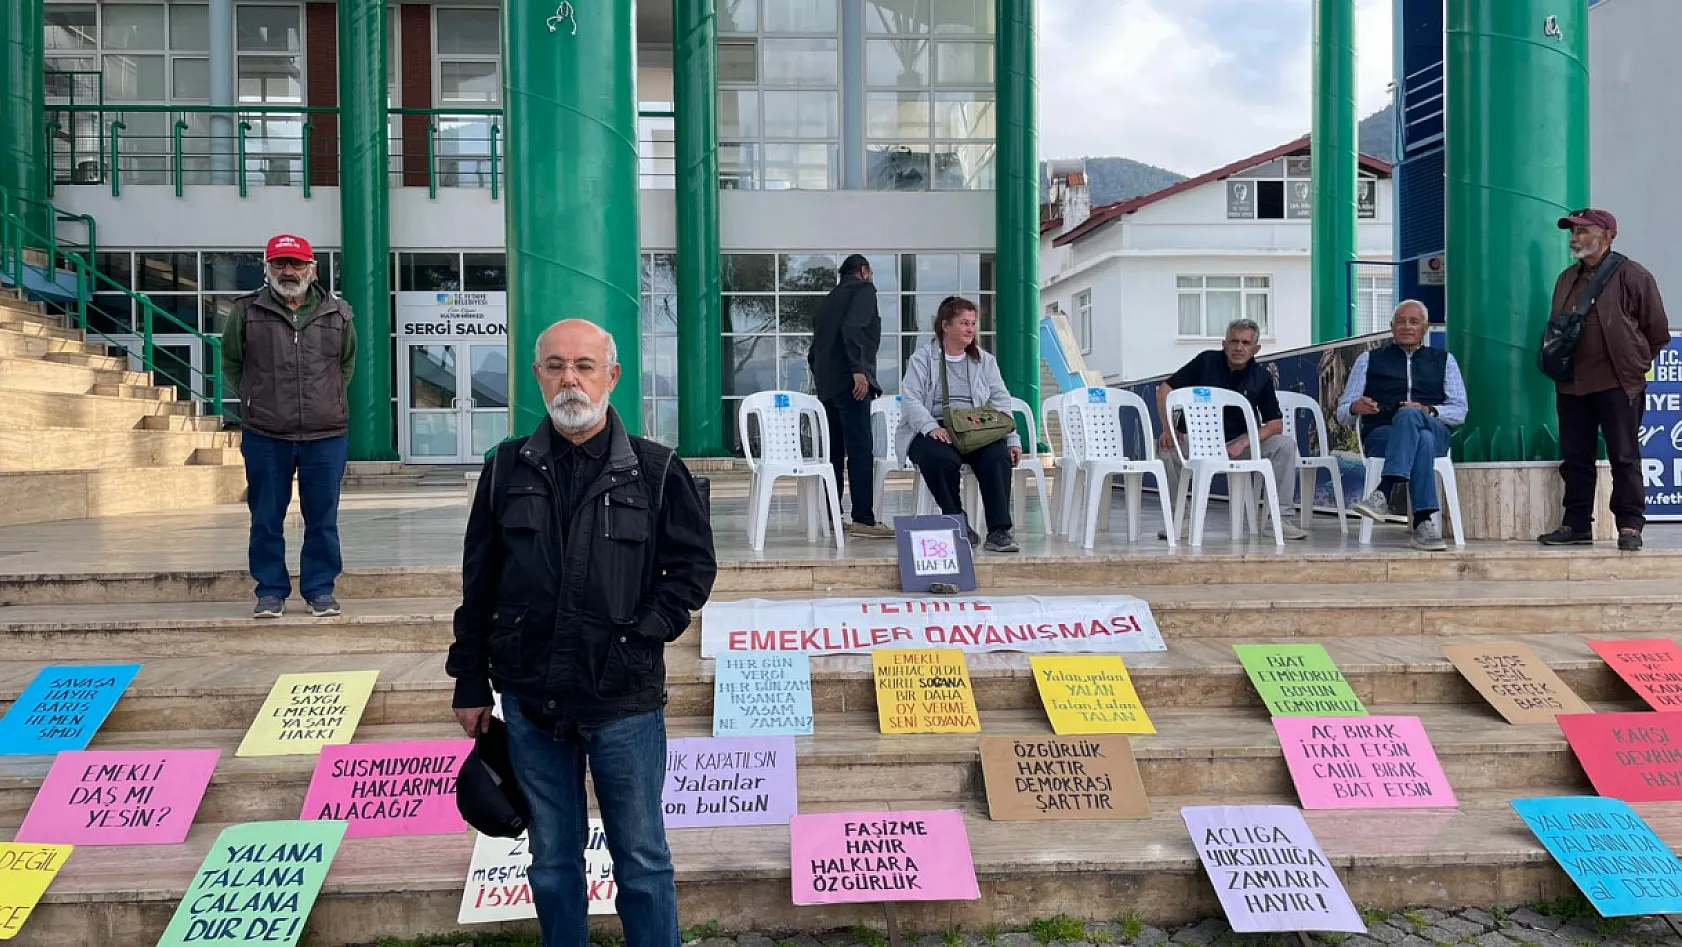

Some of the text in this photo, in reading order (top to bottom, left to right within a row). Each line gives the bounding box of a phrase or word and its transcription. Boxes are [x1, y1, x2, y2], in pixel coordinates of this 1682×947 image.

[404, 320, 451, 335] SERGİ
[916, 559, 957, 571] HAFTA
[728, 622, 914, 651] EMEKLİLER
[726, 655, 793, 669] HER GÜN
[894, 652, 940, 665] EMEKLİ
[1266, 653, 1305, 667] BİAT
[740, 668, 785, 680] VERGİ
[930, 665, 961, 676] OLDU
[1258, 669, 1345, 683] ETMİYORUZ
[719, 682, 751, 693] HER
[879, 678, 913, 689] KURU
[1066, 684, 1115, 696] YALAN
[1280, 685, 1338, 697] BOYUN
[44, 689, 99, 700] HAYIR
[291, 695, 341, 706] SAYGI
[731, 692, 796, 704] İNSANCA
[924, 690, 963, 701] DAHA
[896, 702, 969, 715] OY VERME
[1079, 711, 1137, 722] TALAN
[24, 714, 85, 726] HEMEN
[719, 716, 813, 730] NE ZAMAN?
[924, 715, 976, 727] SOYANA
[279, 729, 335, 740] HAKKI
[1311, 724, 1401, 741] AÇ BIRAK
[1013, 740, 1106, 758] ÖZGÜRLÜK
[1300, 739, 1411, 758] İTAAT ETSİN
[331, 755, 457, 777] SUSMUYORUZ
[695, 750, 777, 770] KAPATILSIN
[1017, 760, 1088, 775] HAKTIR
[1312, 759, 1425, 778] CAHİL BIRAK
[81, 759, 167, 782] EMEKLİ
[673, 773, 766, 792] Yalanlar
[1015, 773, 1113, 793] DEMOKRASİ
[1333, 779, 1432, 798] BİAT ETSİN
[68, 786, 155, 806] DAŞ MI
[1036, 793, 1113, 813] ŞARTTIR
[86, 805, 172, 828] YESİN?
[1527, 813, 1645, 832] YALANINI DA
[844, 819, 928, 839] FAŞİZME
[846, 839, 907, 854] HAYIR
[1546, 833, 1662, 854] TALANINI DA
[0, 848, 58, 871] DEĞİL
[227, 843, 323, 864] YALANA
[811, 856, 919, 875] HALKLARA
[1652, 856, 1682, 875] DA
[198, 867, 305, 889] TALANA
[813, 873, 923, 892] ÖZGÜRLÜK
[1226, 870, 1329, 890] ZAMLARA
[475, 884, 535, 908] İSYA
[1591, 880, 1615, 901] al
[190, 891, 300, 920] ÇALANA
[183, 917, 301, 942] DUR DE!
